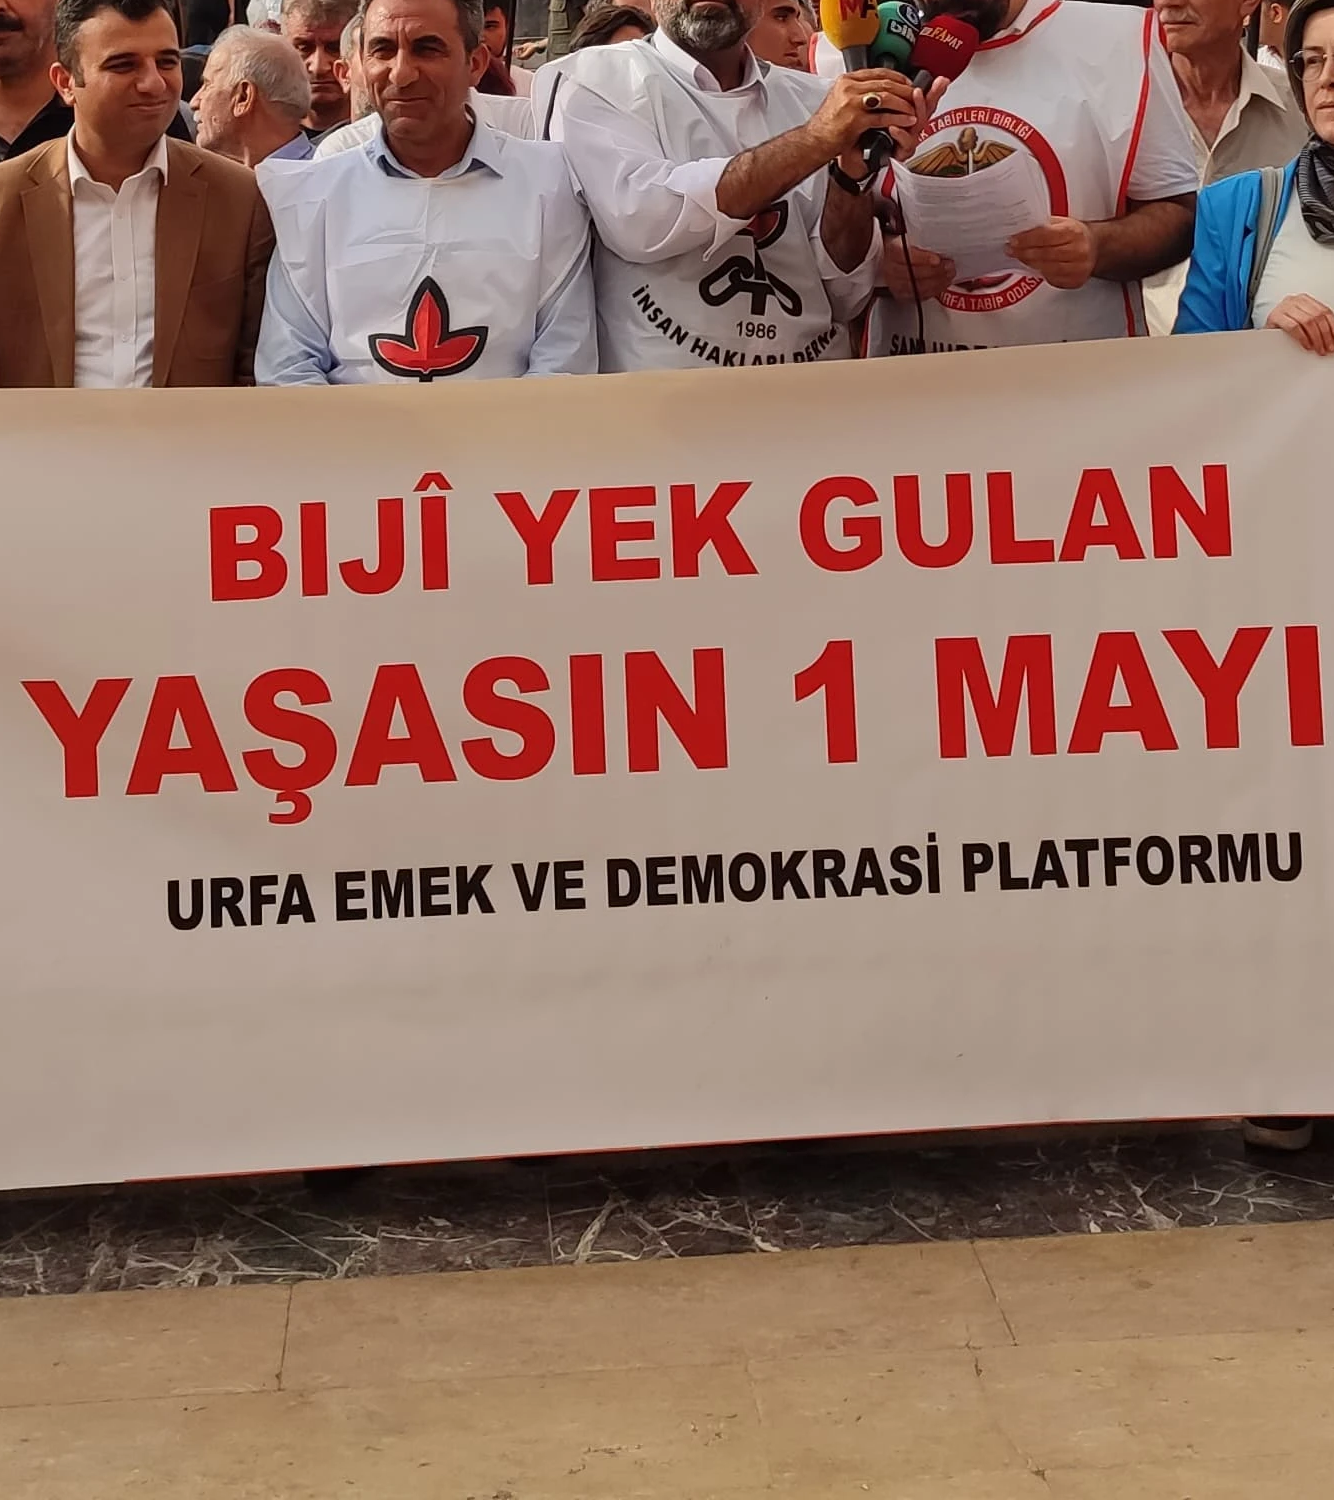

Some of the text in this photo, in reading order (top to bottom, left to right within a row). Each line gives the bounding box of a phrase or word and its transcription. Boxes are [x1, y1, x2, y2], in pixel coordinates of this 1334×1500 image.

[631, 283, 690, 346] İNSAN
[736, 321, 777, 340] 1986
[969, 294, 1004, 311] TABİP
[209, 463, 1233, 601] BIJÎ YEK GULAN
[20, 646, 729, 825] YAŞASIN
[793, 639, 858, 764] 1
[167, 831, 1304, 931] URFA EMEK VE DEMOKRASİ PLATFORMU
